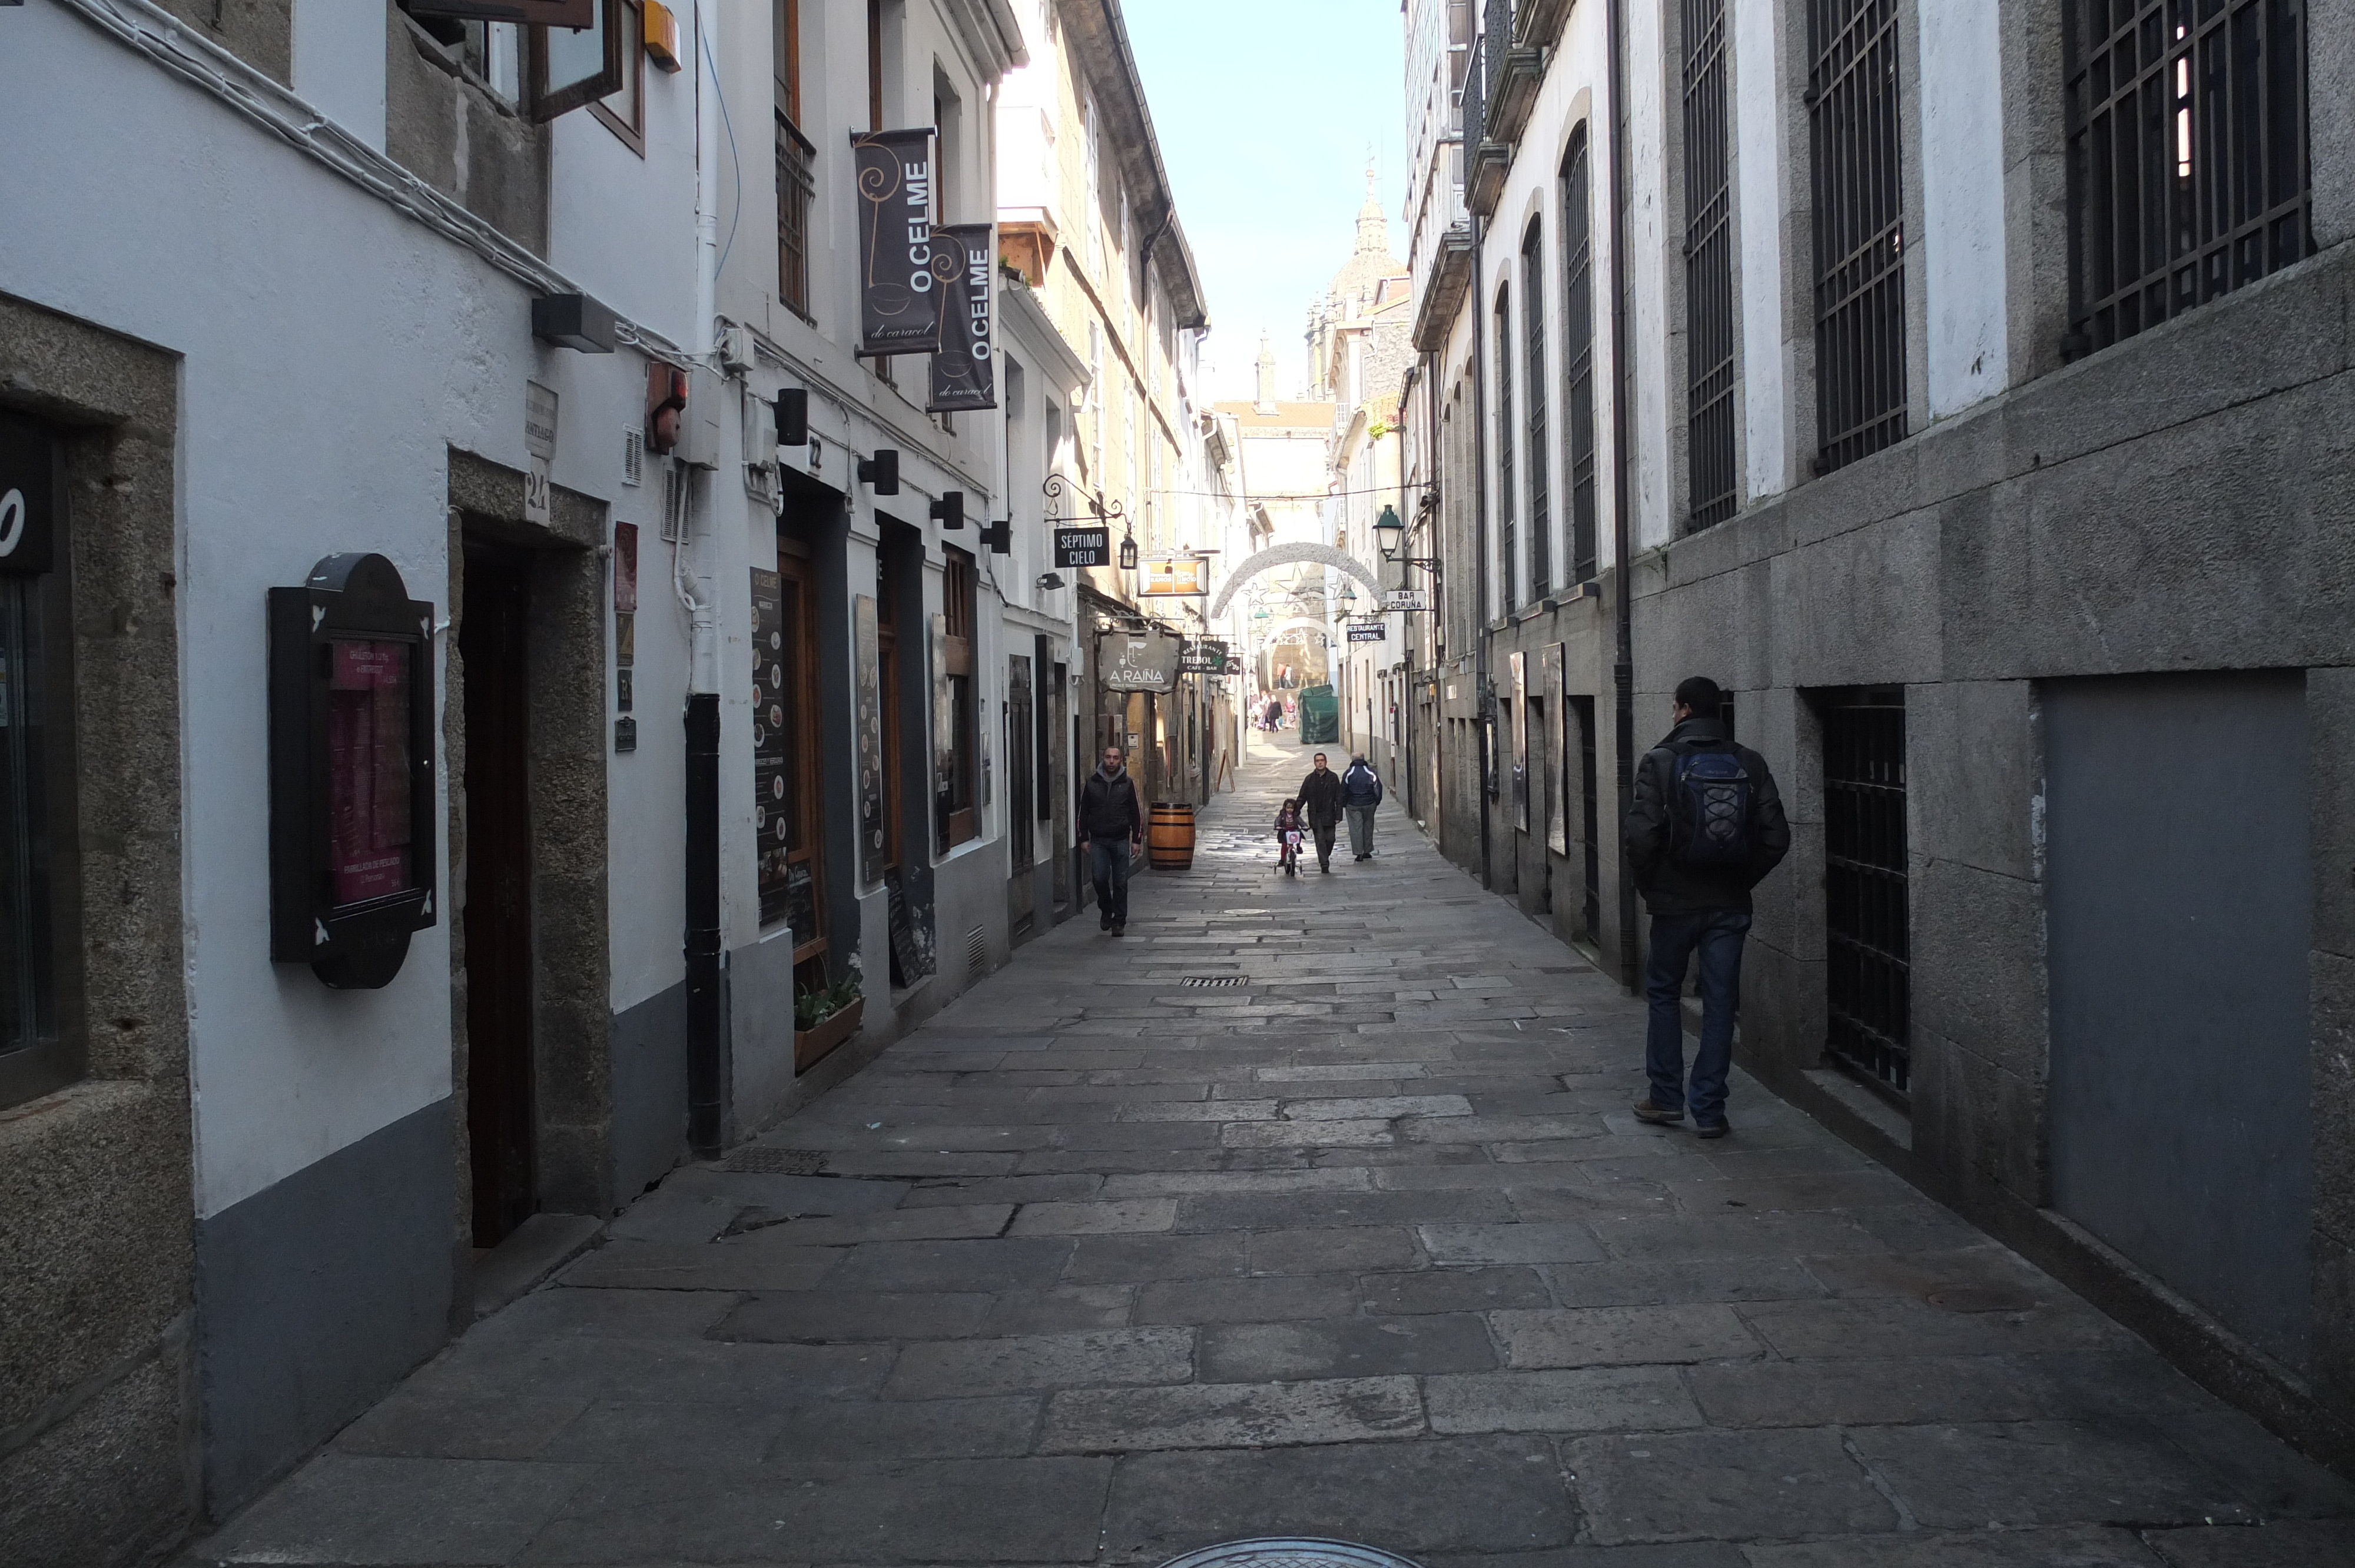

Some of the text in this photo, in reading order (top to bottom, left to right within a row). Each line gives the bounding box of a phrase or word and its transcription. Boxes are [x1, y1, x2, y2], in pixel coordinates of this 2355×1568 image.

[905, 161, 932, 293] O CELME
[970, 249, 991, 360] O CELME
[871, 321, 934, 338] do caracol
[528, 471, 546, 510] 24
[1061, 532, 1103, 549] SÉPTIMO
[1069, 550, 1095, 564] CIELO
[1391, 600, 1422, 609] CORUÑA
[1346, 624, 1384, 632] RESTAURANTE
[1351, 633, 1381, 641] CENTRAL
[1183, 644, 1223, 656] RESTAURANTE
[1181, 656, 1212, 665] TREBOL
[1109, 670, 1121, 683] A
